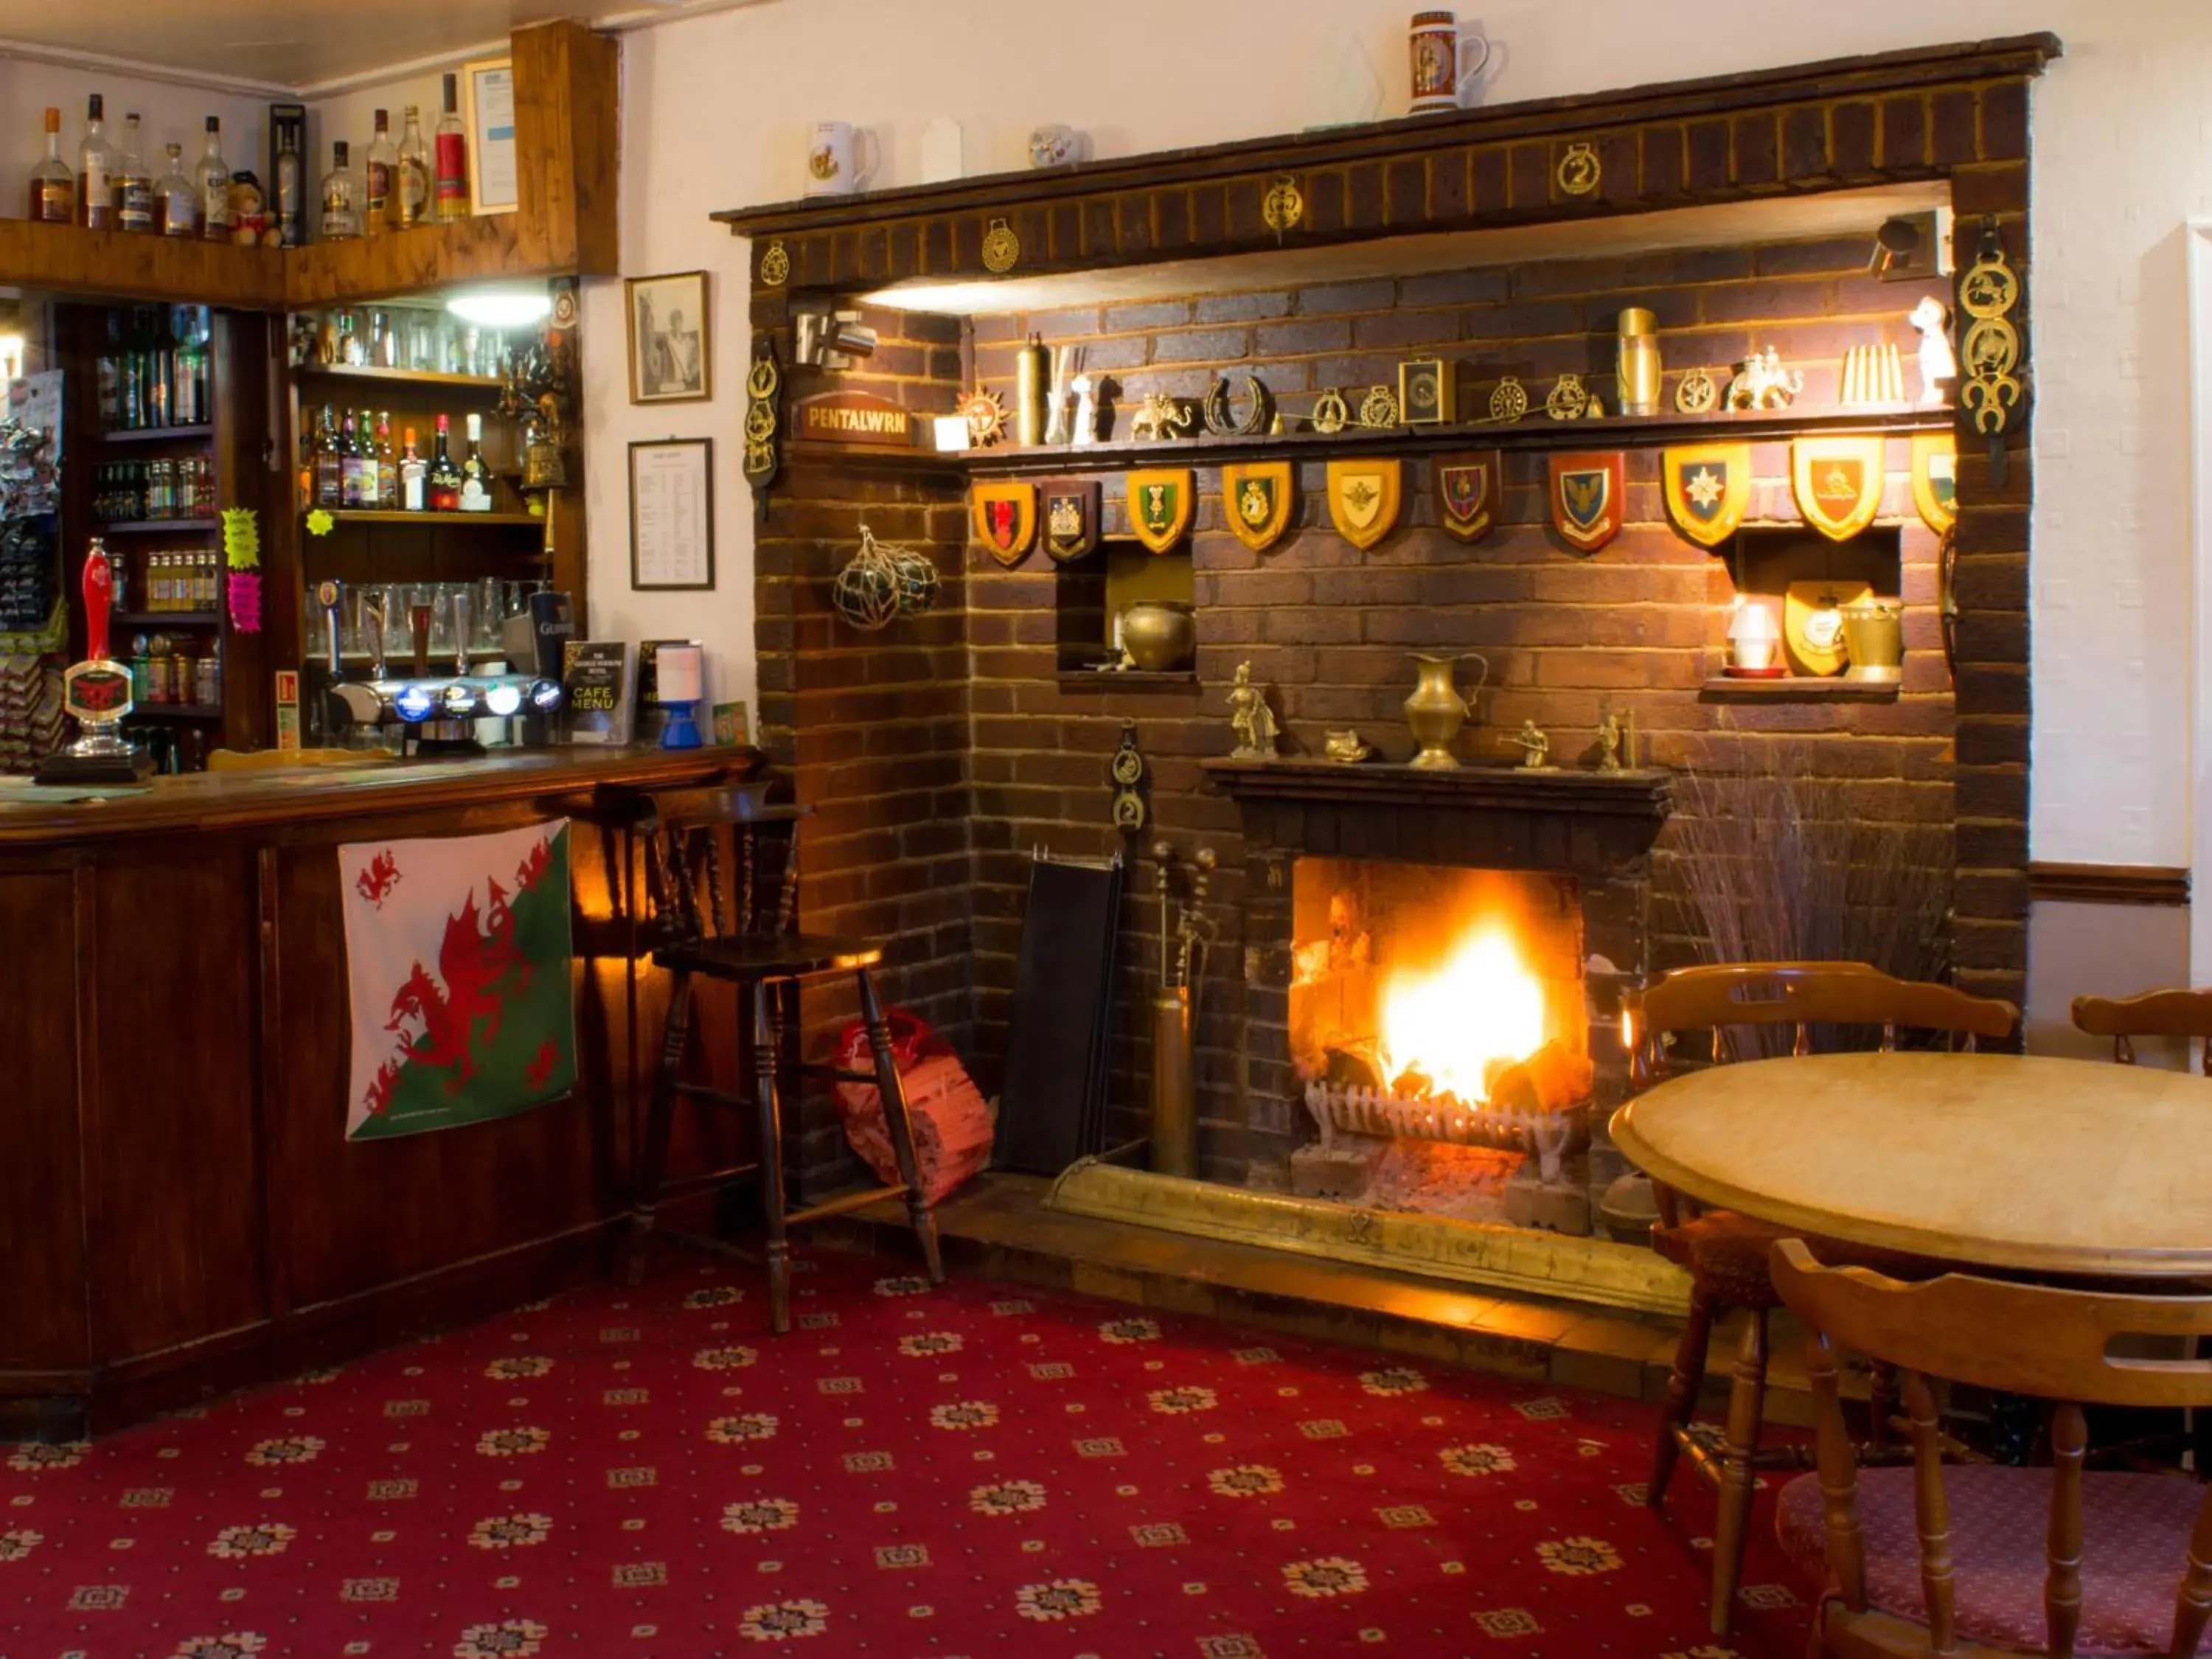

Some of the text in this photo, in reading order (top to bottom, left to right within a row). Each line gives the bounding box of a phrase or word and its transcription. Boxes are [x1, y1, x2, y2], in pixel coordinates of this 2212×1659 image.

[809, 407, 906, 434] PENTALWRN
[574, 686, 612, 698] CAFE
[571, 698, 613, 709] MENU
